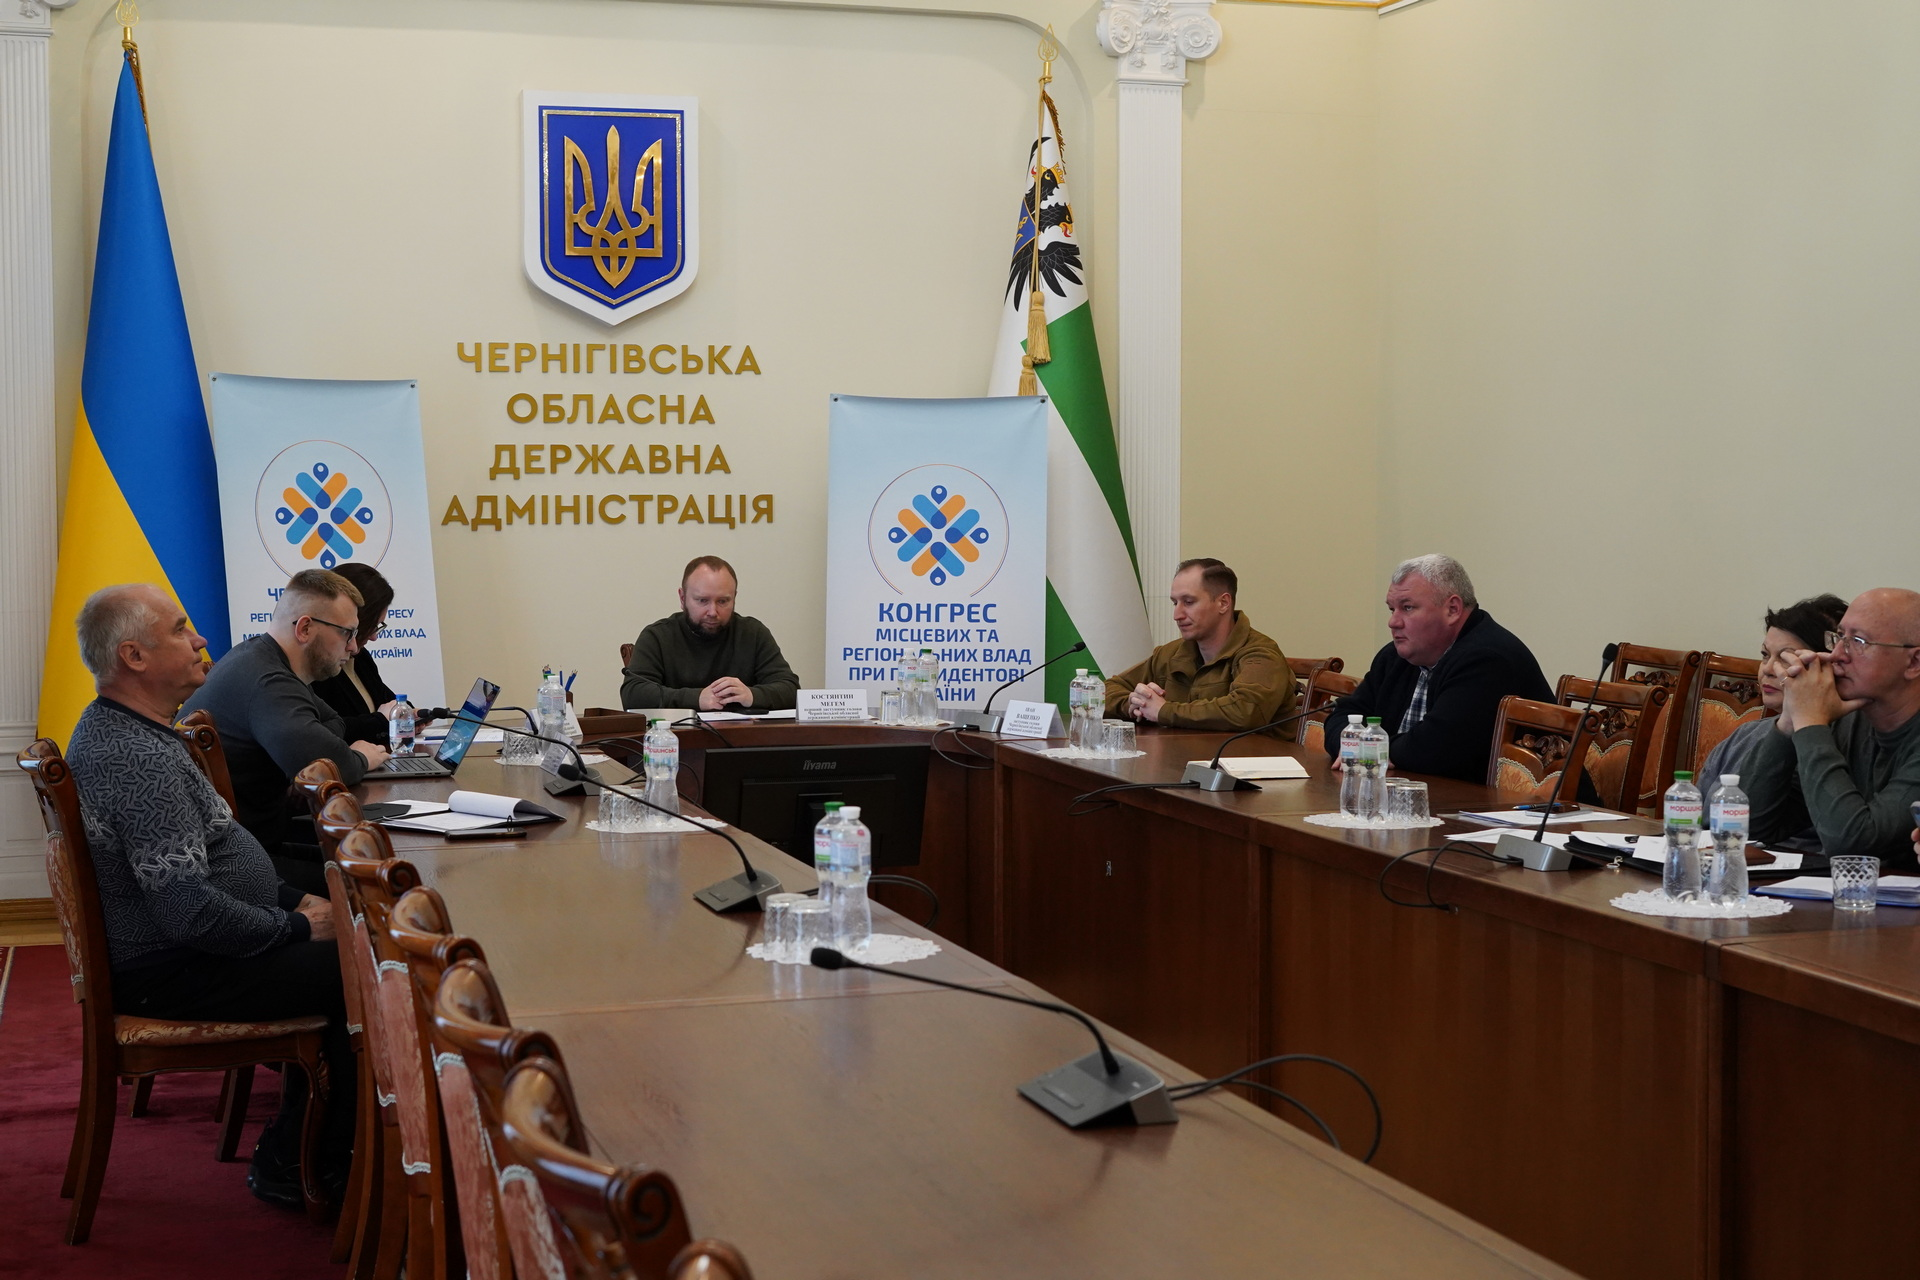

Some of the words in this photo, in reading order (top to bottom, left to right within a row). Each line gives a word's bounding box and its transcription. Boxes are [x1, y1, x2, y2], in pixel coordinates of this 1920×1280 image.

[457, 342, 761, 375] ЧЕРНІГІВСЬКА
[506, 393, 716, 424] ОБЛАСНА
[489, 444, 732, 480] ДЕРЖАВНА
[441, 494, 773, 531] АДМІНІСТРАЦІЯ
[387, 608, 415, 619] РЕСУ
[878, 602, 997, 623] КОНГРЕС
[394, 627, 427, 639] ВЛАД
[875, 628, 971, 644] МІСЦЕВИХ
[975, 629, 1000, 643] ТА
[982, 648, 1032, 665] ВЛАД
[849, 667, 885, 681] ПРИ
[803, 760, 837, 770] iiyama
